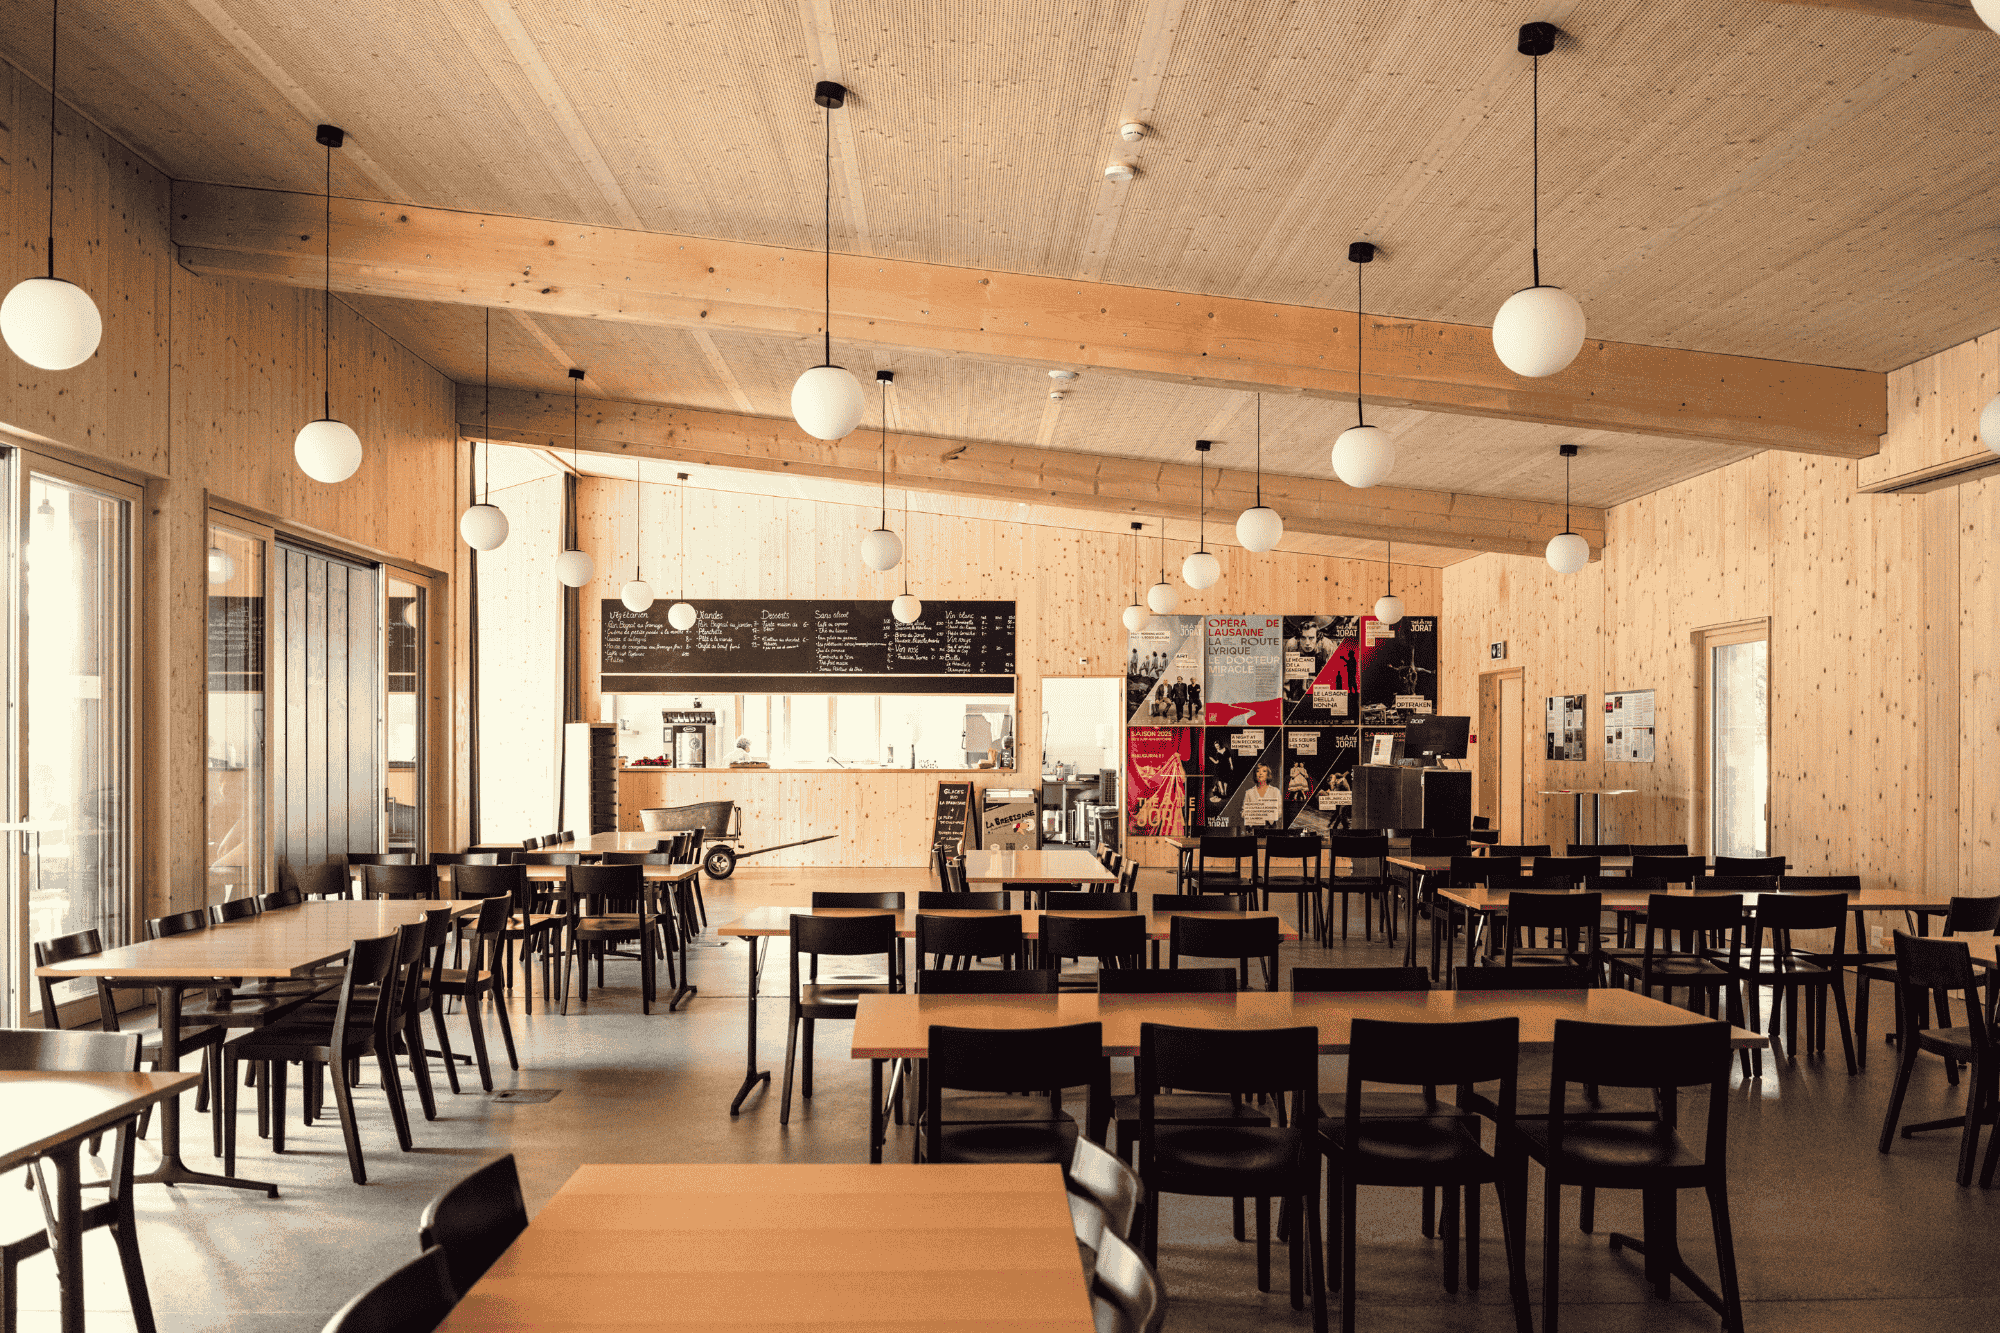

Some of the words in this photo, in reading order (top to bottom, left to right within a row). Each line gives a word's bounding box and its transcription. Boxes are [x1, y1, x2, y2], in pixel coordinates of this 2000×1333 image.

[609, 611, 649, 621] Végétarien
[761, 609, 789, 619] Desserts
[815, 610, 831, 619] Sans
[833, 611, 849, 619] alcool
[945, 611, 956, 619] Vin
[959, 611, 974, 619] blanc
[1208, 617, 1247, 627] OPÉRA
[1266, 619, 1279, 628] DE
[1208, 628, 1263, 637] LAUSANNE
[1410, 624, 1432, 632] JORAT
[1208, 637, 1222, 646] LA
[1241, 637, 1280, 646] ROUTE
[1208, 647, 1251, 655] LYRIQUE
[1208, 656, 1220, 664] LE
[1226, 655, 1280, 665] DOCTEUR
[1208, 665, 1254, 674] MIRACLE
